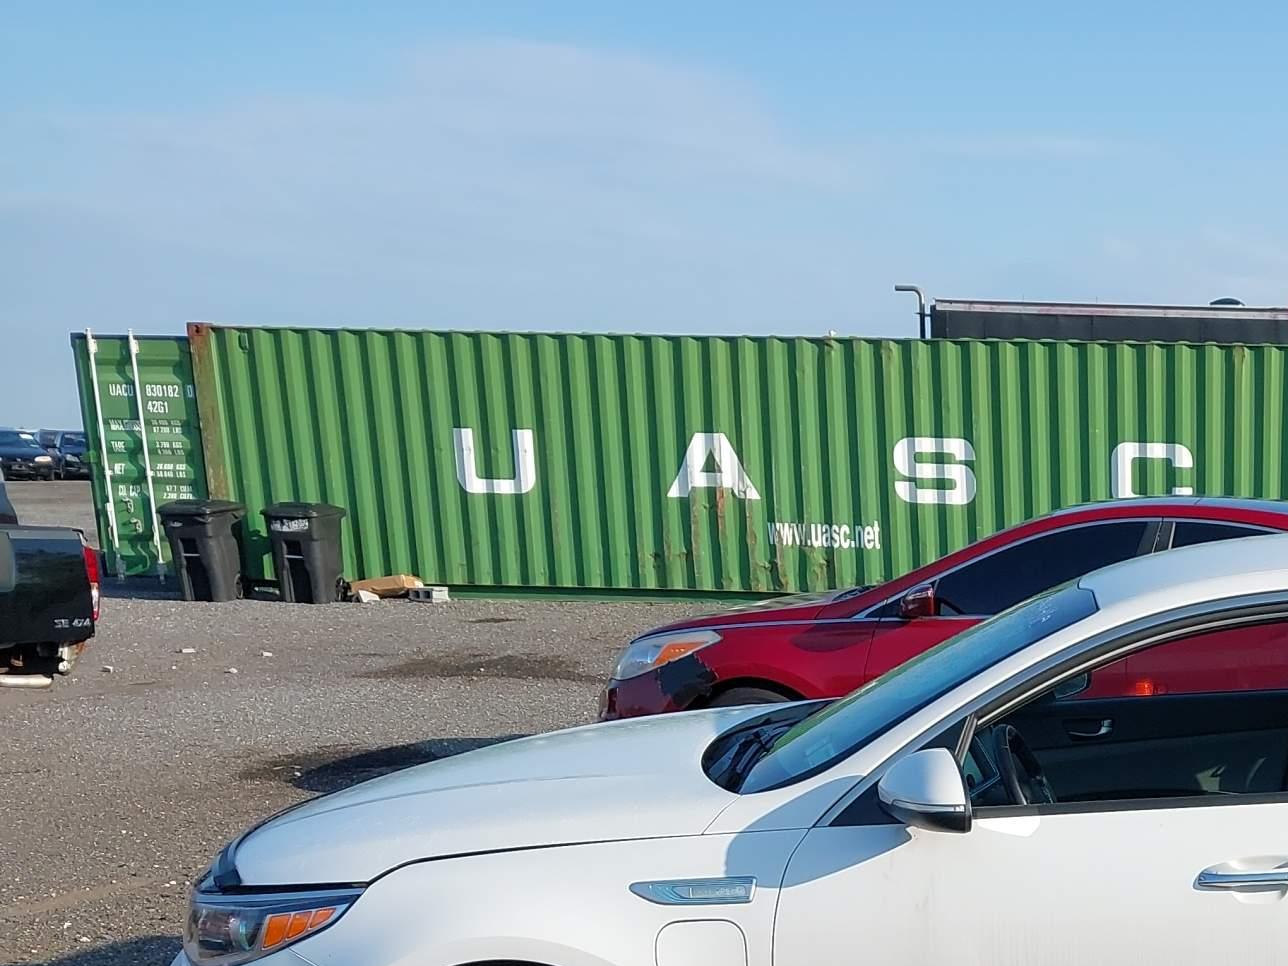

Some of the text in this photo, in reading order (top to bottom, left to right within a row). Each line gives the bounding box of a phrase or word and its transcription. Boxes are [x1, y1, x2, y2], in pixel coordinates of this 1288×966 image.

[109, 383, 134, 397] UACU
[145, 384, 180, 398] 830182
[147, 400, 169, 414] 42G1
[767, 520, 880, 549] www.uasc.net
